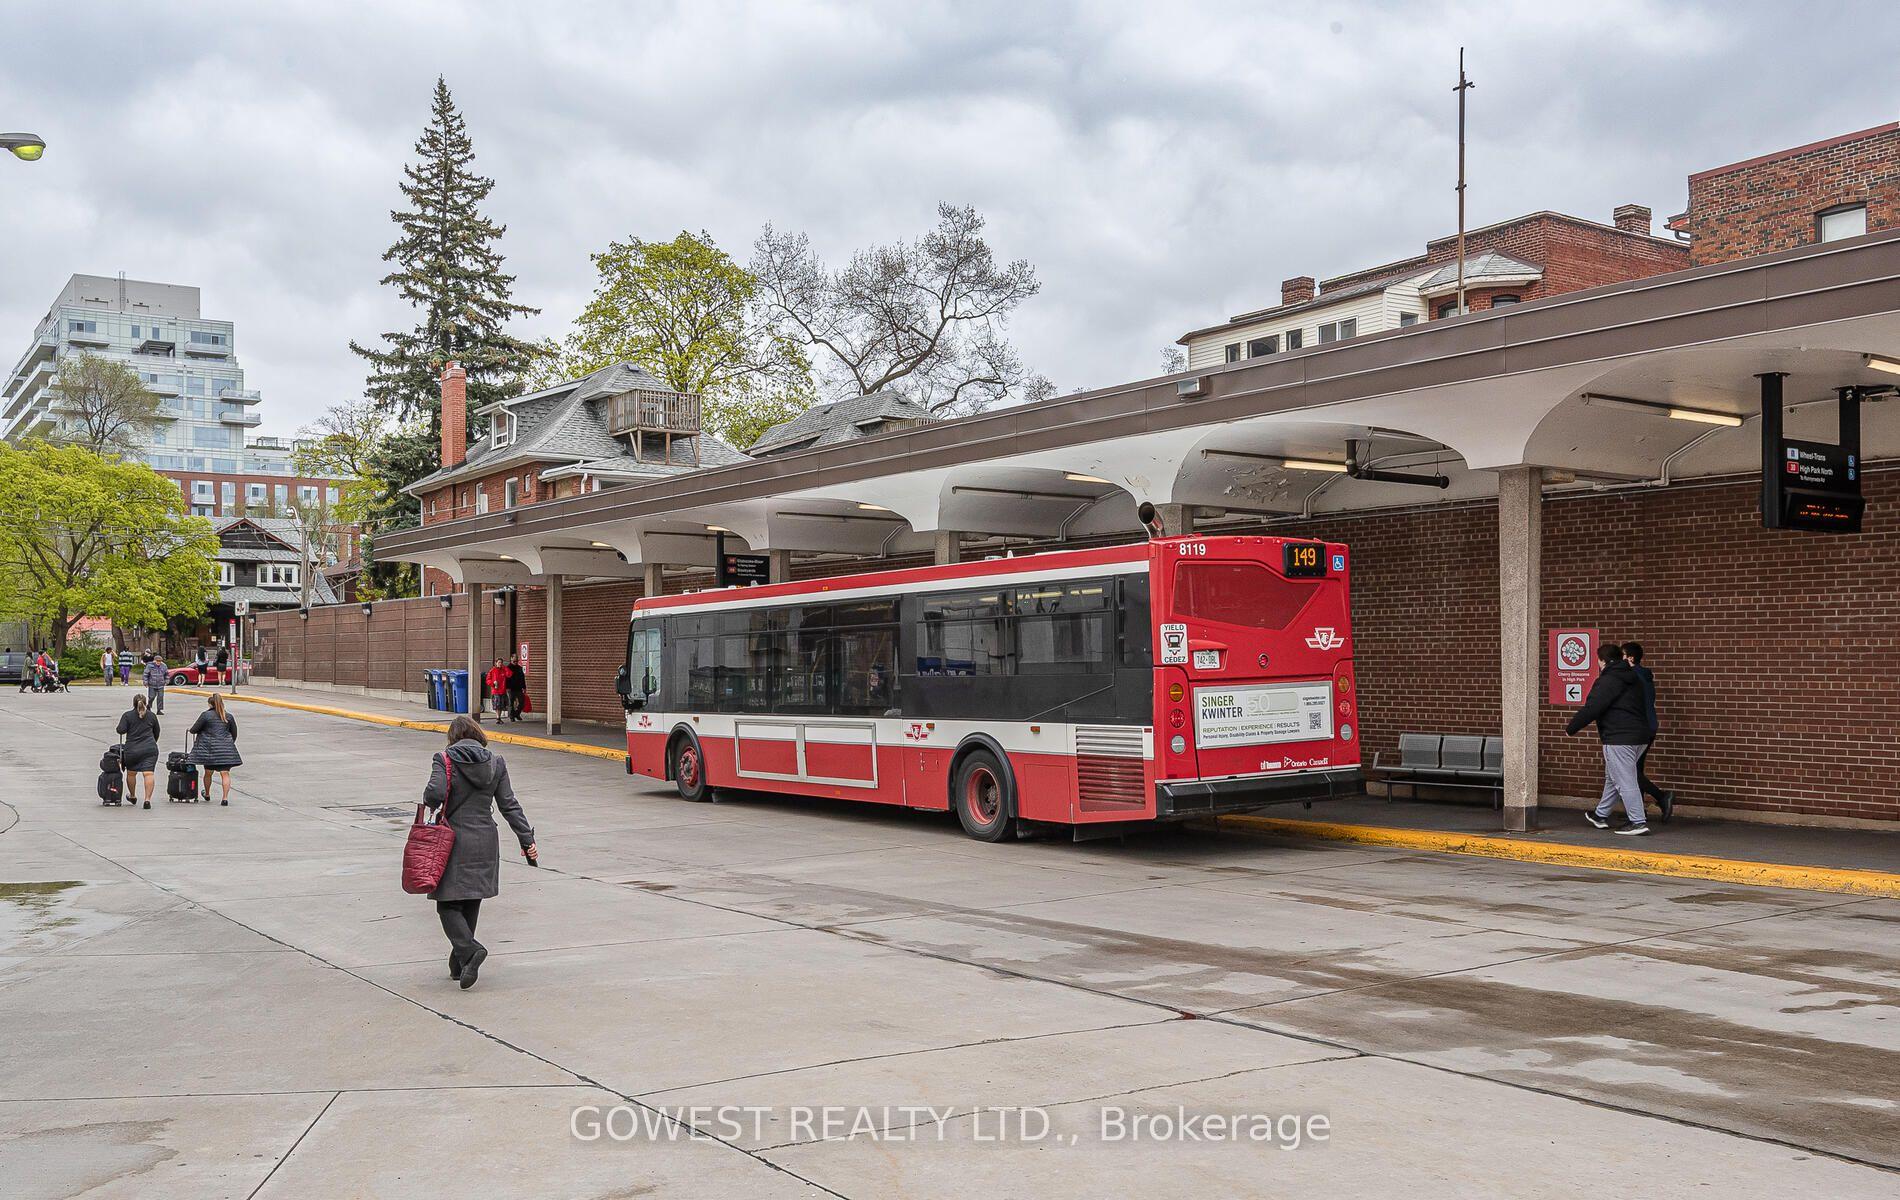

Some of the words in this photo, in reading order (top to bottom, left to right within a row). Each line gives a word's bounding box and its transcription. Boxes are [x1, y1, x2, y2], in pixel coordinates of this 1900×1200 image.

[1800, 465, 1810, 474] High
[1811, 466, 1821, 474] Park
[1821, 467, 1833, 475] North
[1179, 543, 1206, 555] 8119
[1294, 547, 1316, 566] 149
[1201, 695, 1235, 708] SINGER
[1201, 706, 1243, 720] KWINTER
[1202, 726, 1238, 734] REPUTATION
[1240, 723, 1274, 731] EXPERIENCE
[1276, 721, 1300, 729] RESULTS
